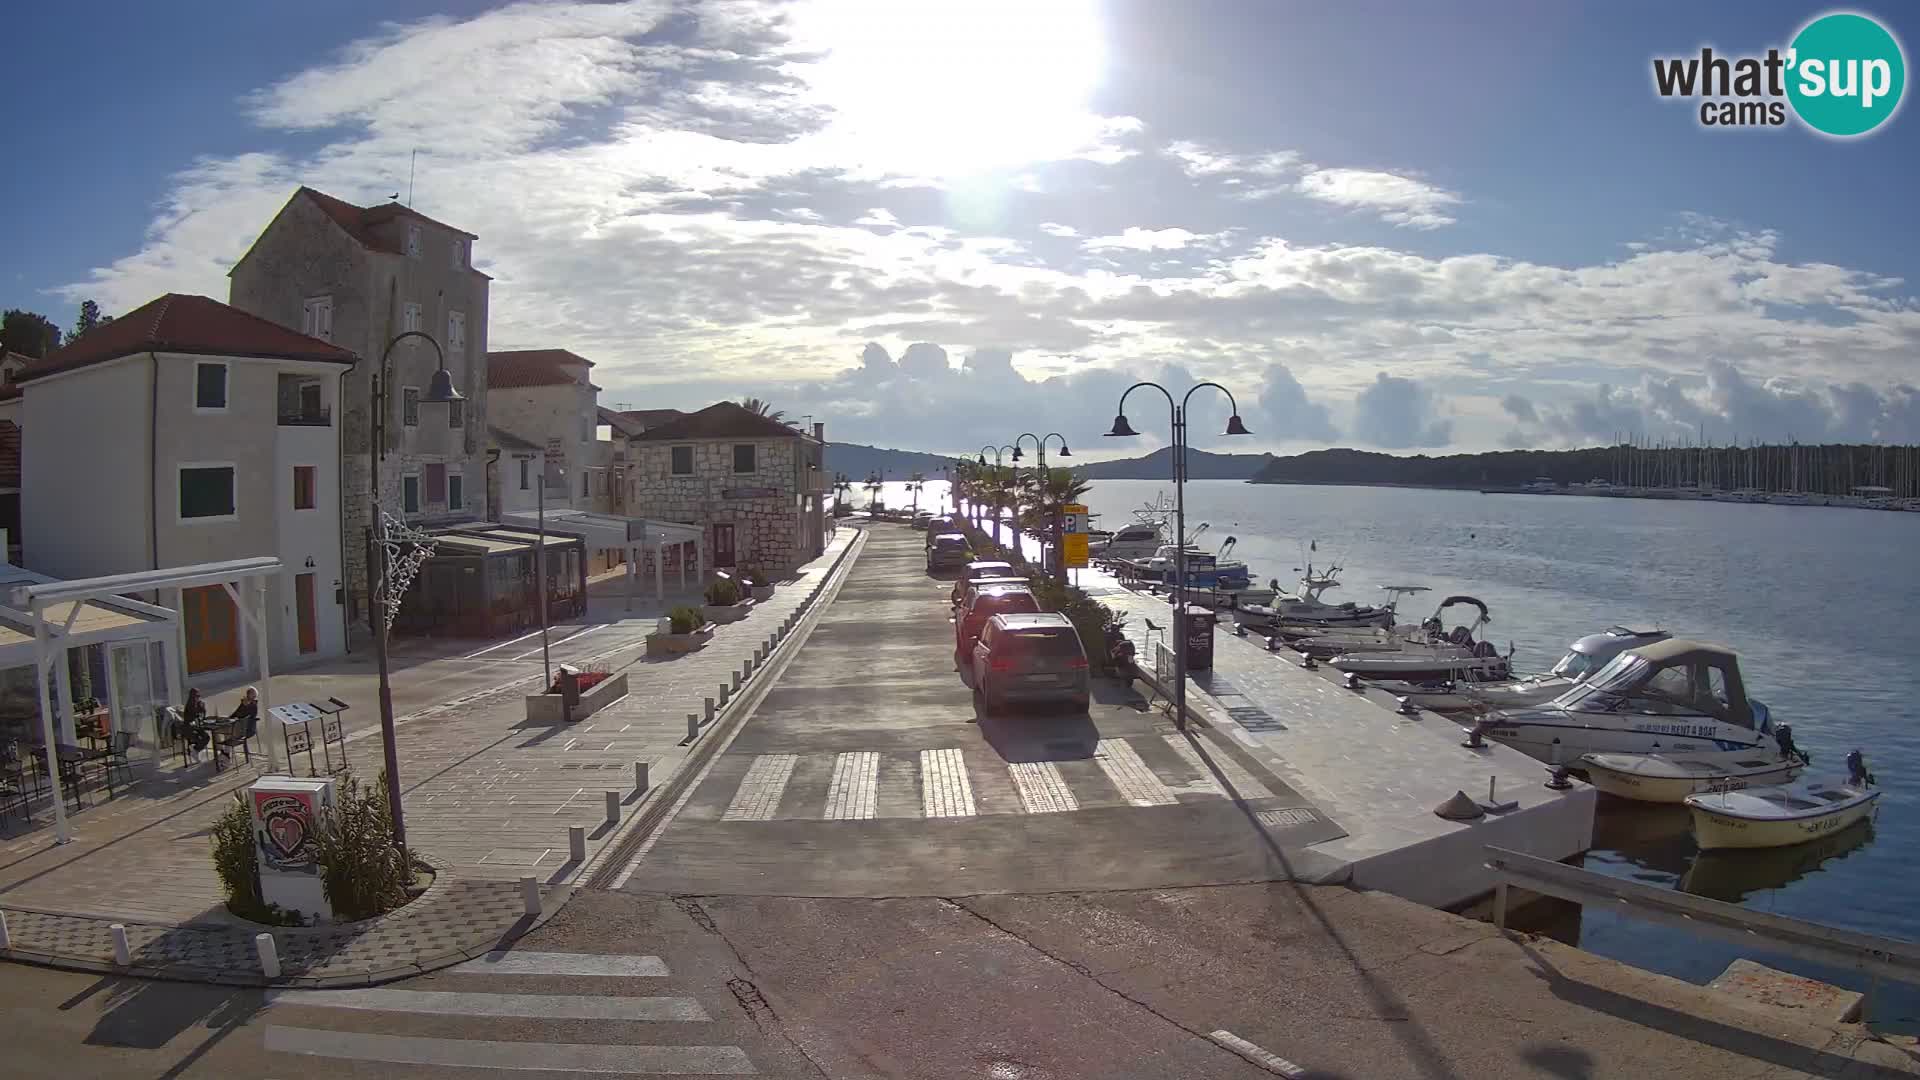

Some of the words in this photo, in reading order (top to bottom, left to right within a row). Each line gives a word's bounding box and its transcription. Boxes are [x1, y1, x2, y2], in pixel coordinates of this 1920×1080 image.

[1065, 515, 1075, 531] P
[1670, 722, 1690, 736] RENT
[1698, 725, 1718, 737] BOAT
